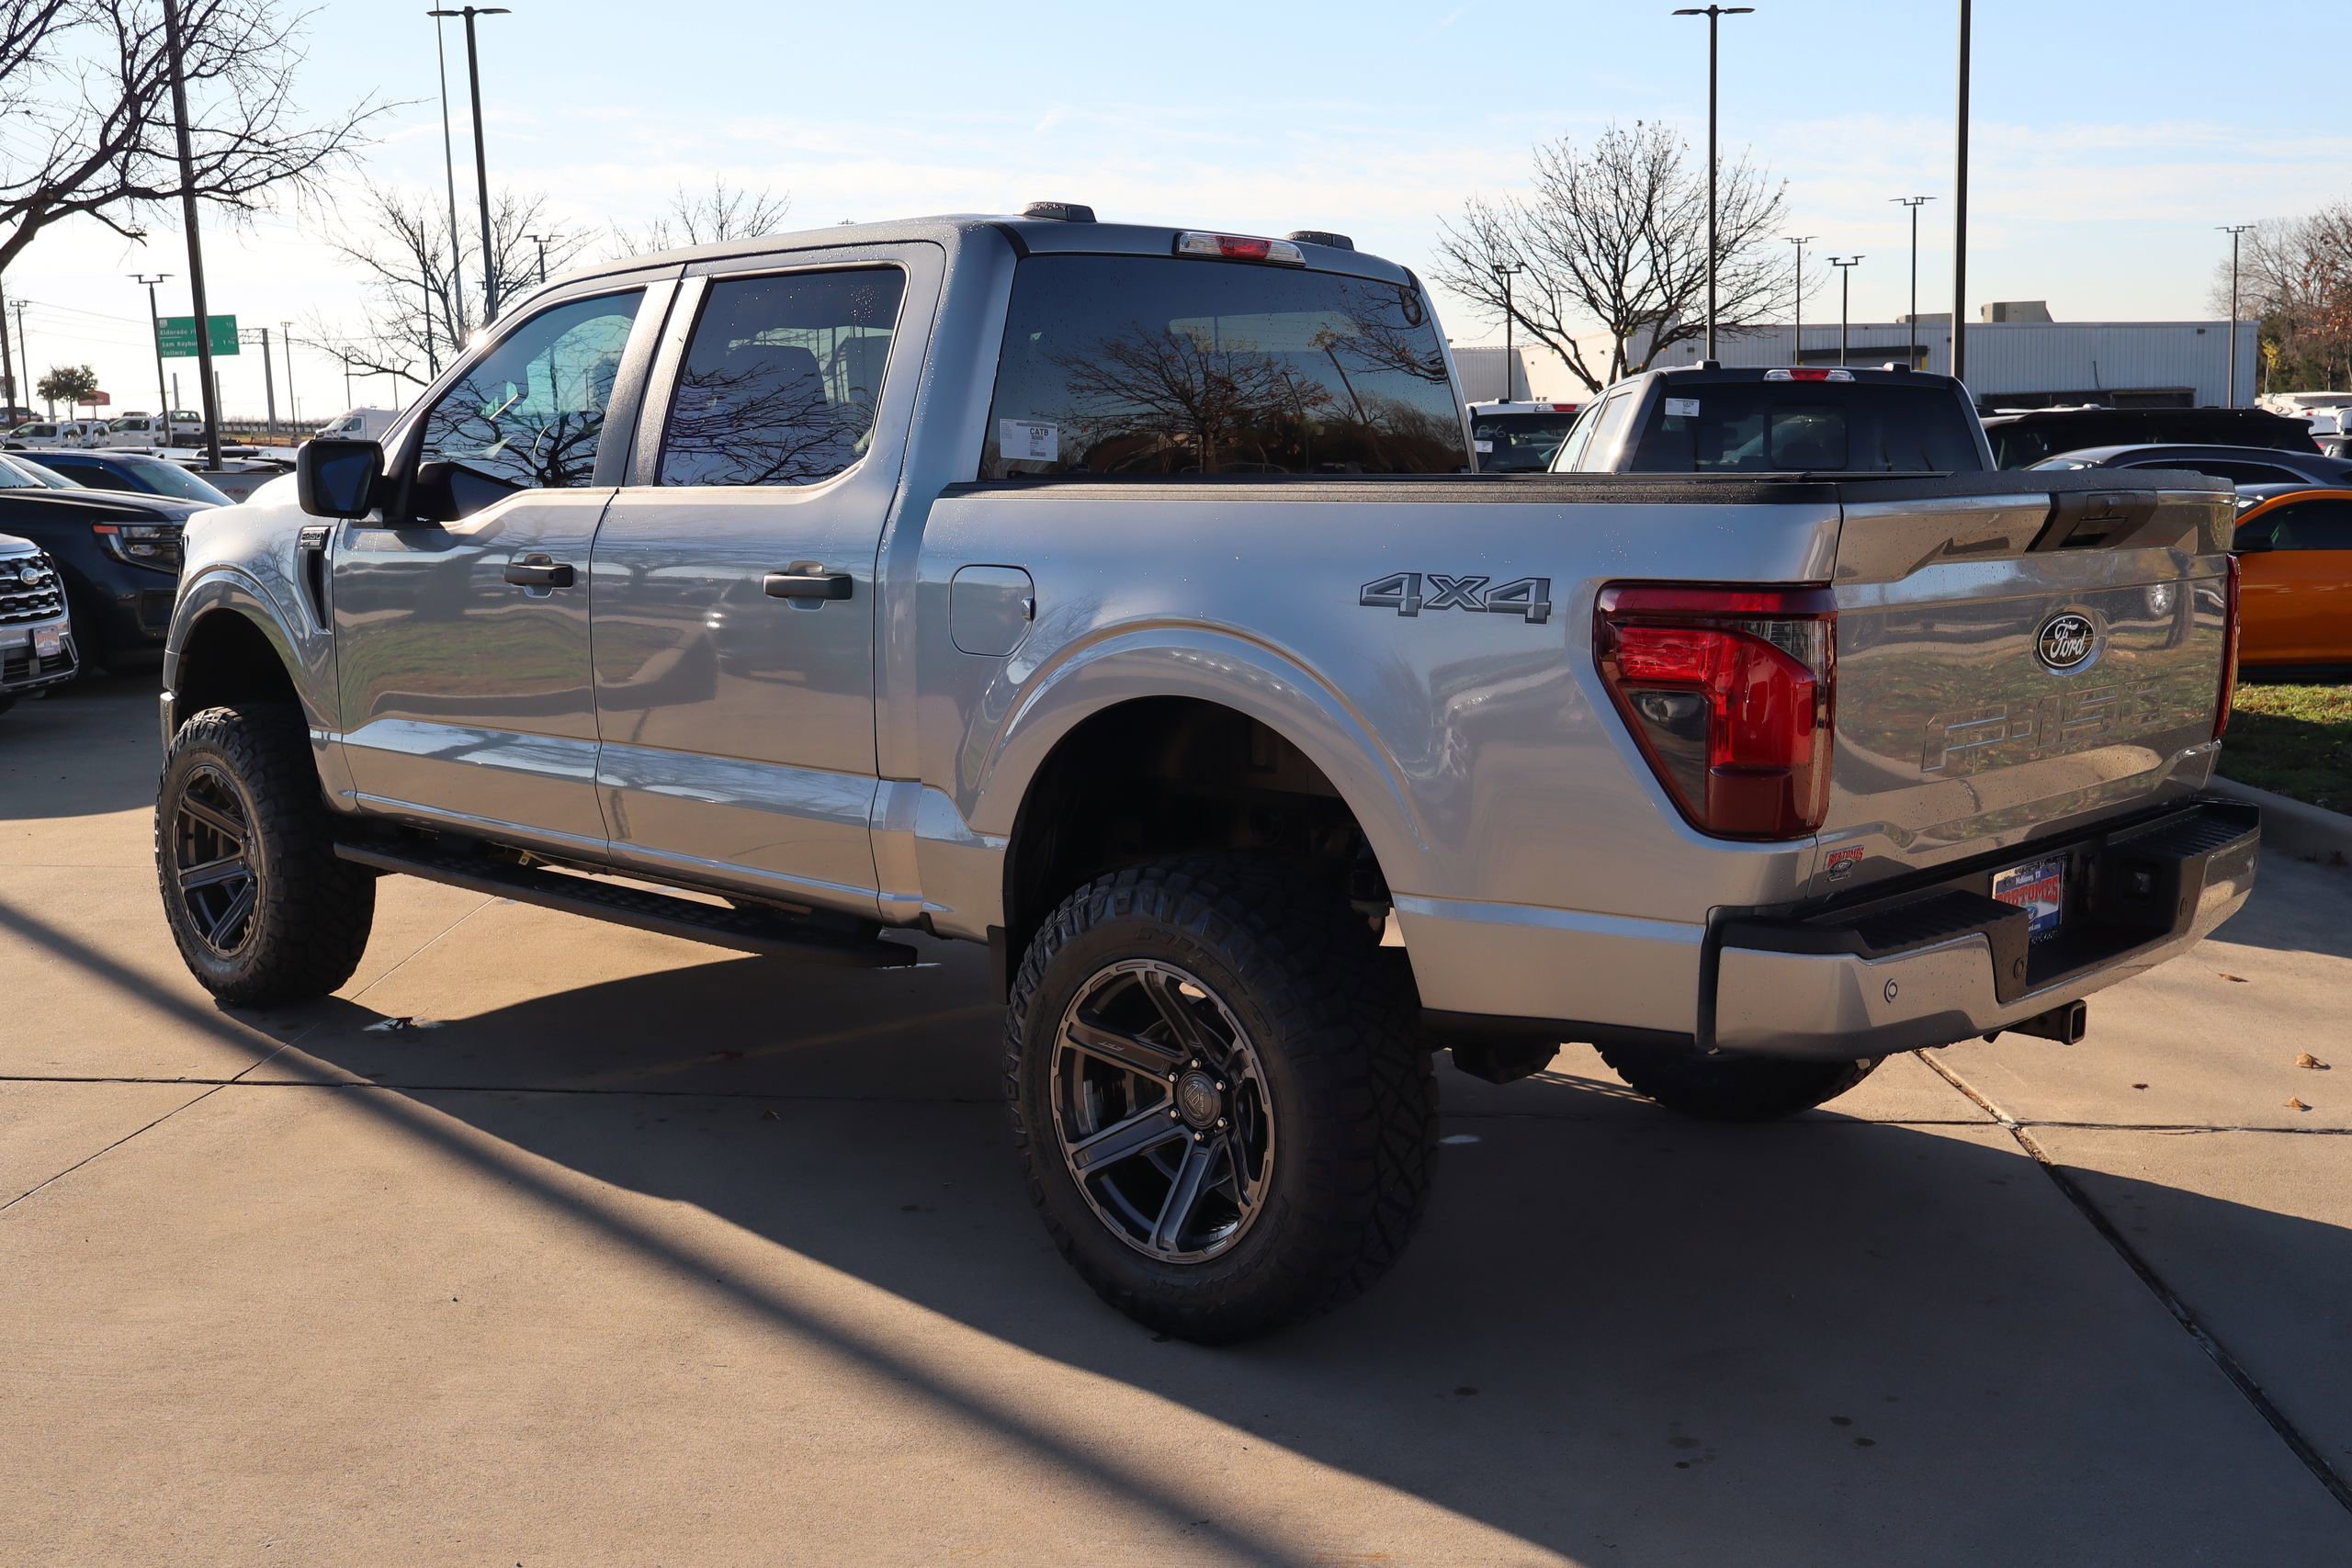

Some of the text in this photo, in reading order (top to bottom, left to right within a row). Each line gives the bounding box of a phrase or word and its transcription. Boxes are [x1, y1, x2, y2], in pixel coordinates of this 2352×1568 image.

[177, 340, 198, 348] Raybu
[1029, 428, 1049, 436] CATB
[2050, 622, 2086, 660] Ford
[2035, 870, 2041, 878] TX
